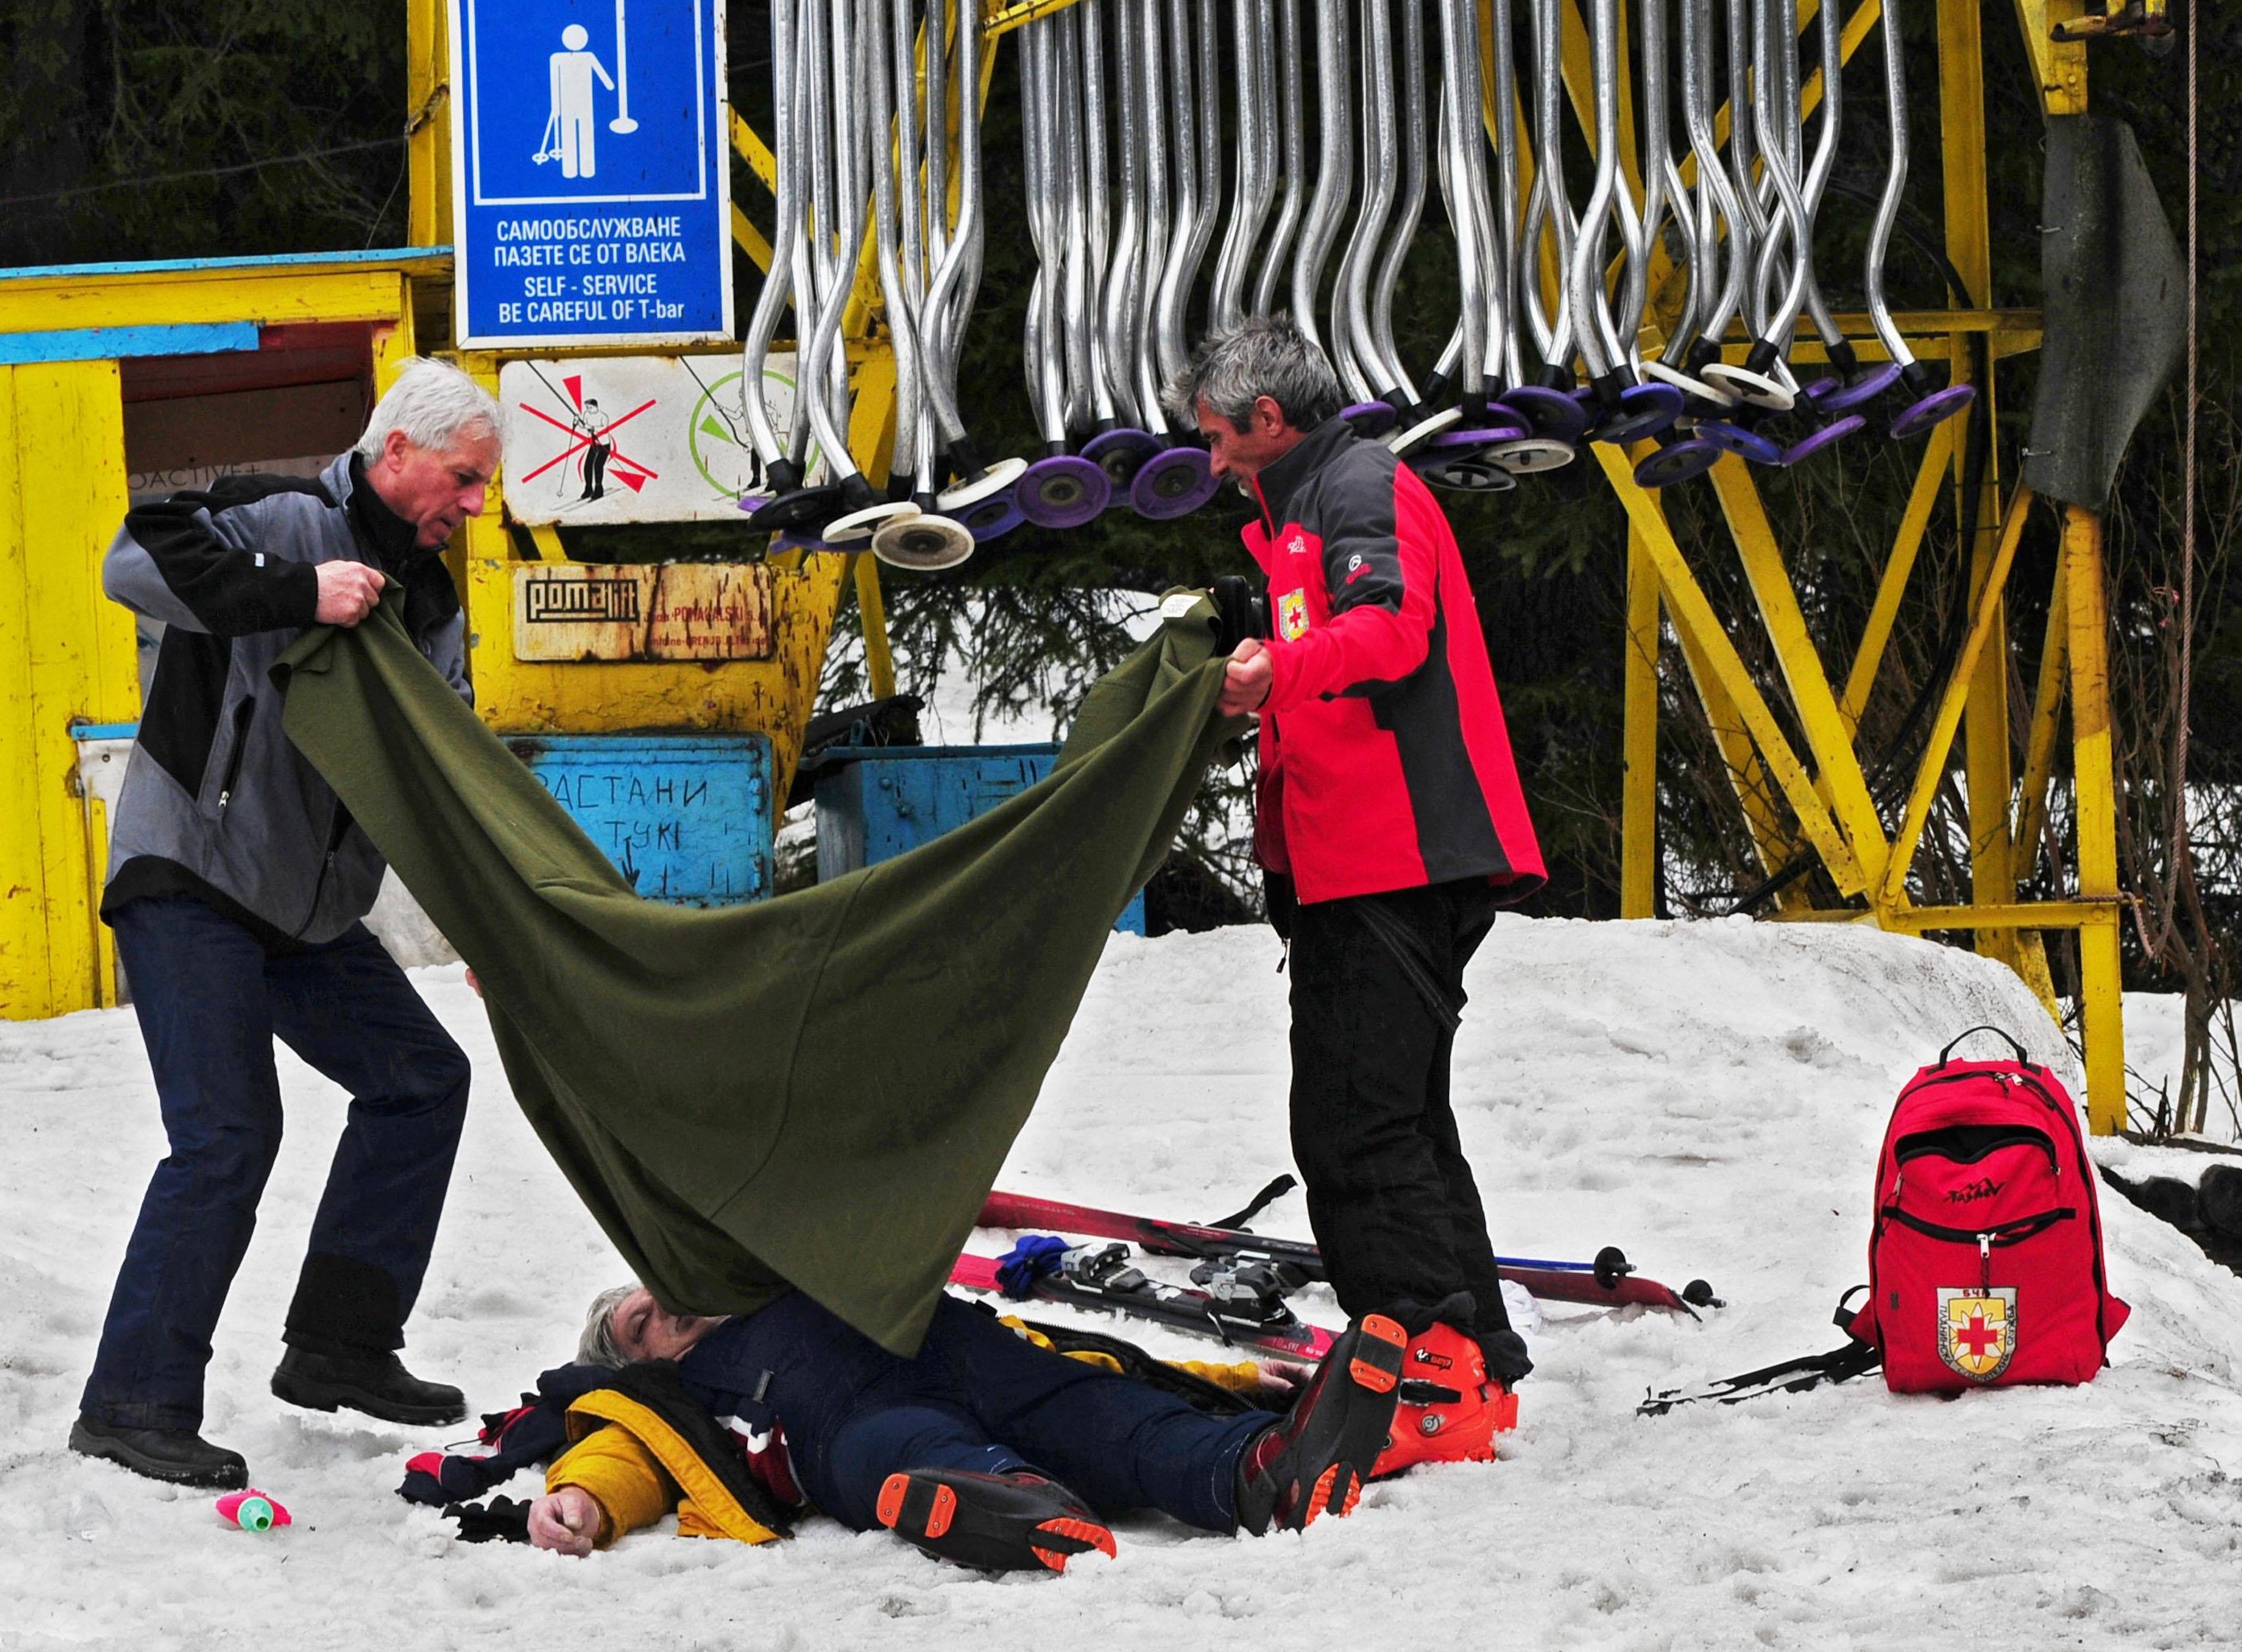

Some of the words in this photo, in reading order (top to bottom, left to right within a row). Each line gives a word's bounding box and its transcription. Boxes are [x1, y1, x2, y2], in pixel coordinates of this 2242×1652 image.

[497, 216, 681, 242] САМООБСЛУЖВАНЕ
[493, 245, 564, 267] ПАЗЕТЕ
[569, 244, 592, 265] СЕ
[597, 243, 621, 264] ОТ
[626, 242, 686, 263] ВЛЕКА
[524, 276, 566, 297] SELF
[583, 274, 658, 295] SERVICE
[499, 303, 522, 324] BE
[527, 300, 607, 322] CAREFUL
[612, 299, 634, 320] OF
[638, 299, 684, 319] T-bar
